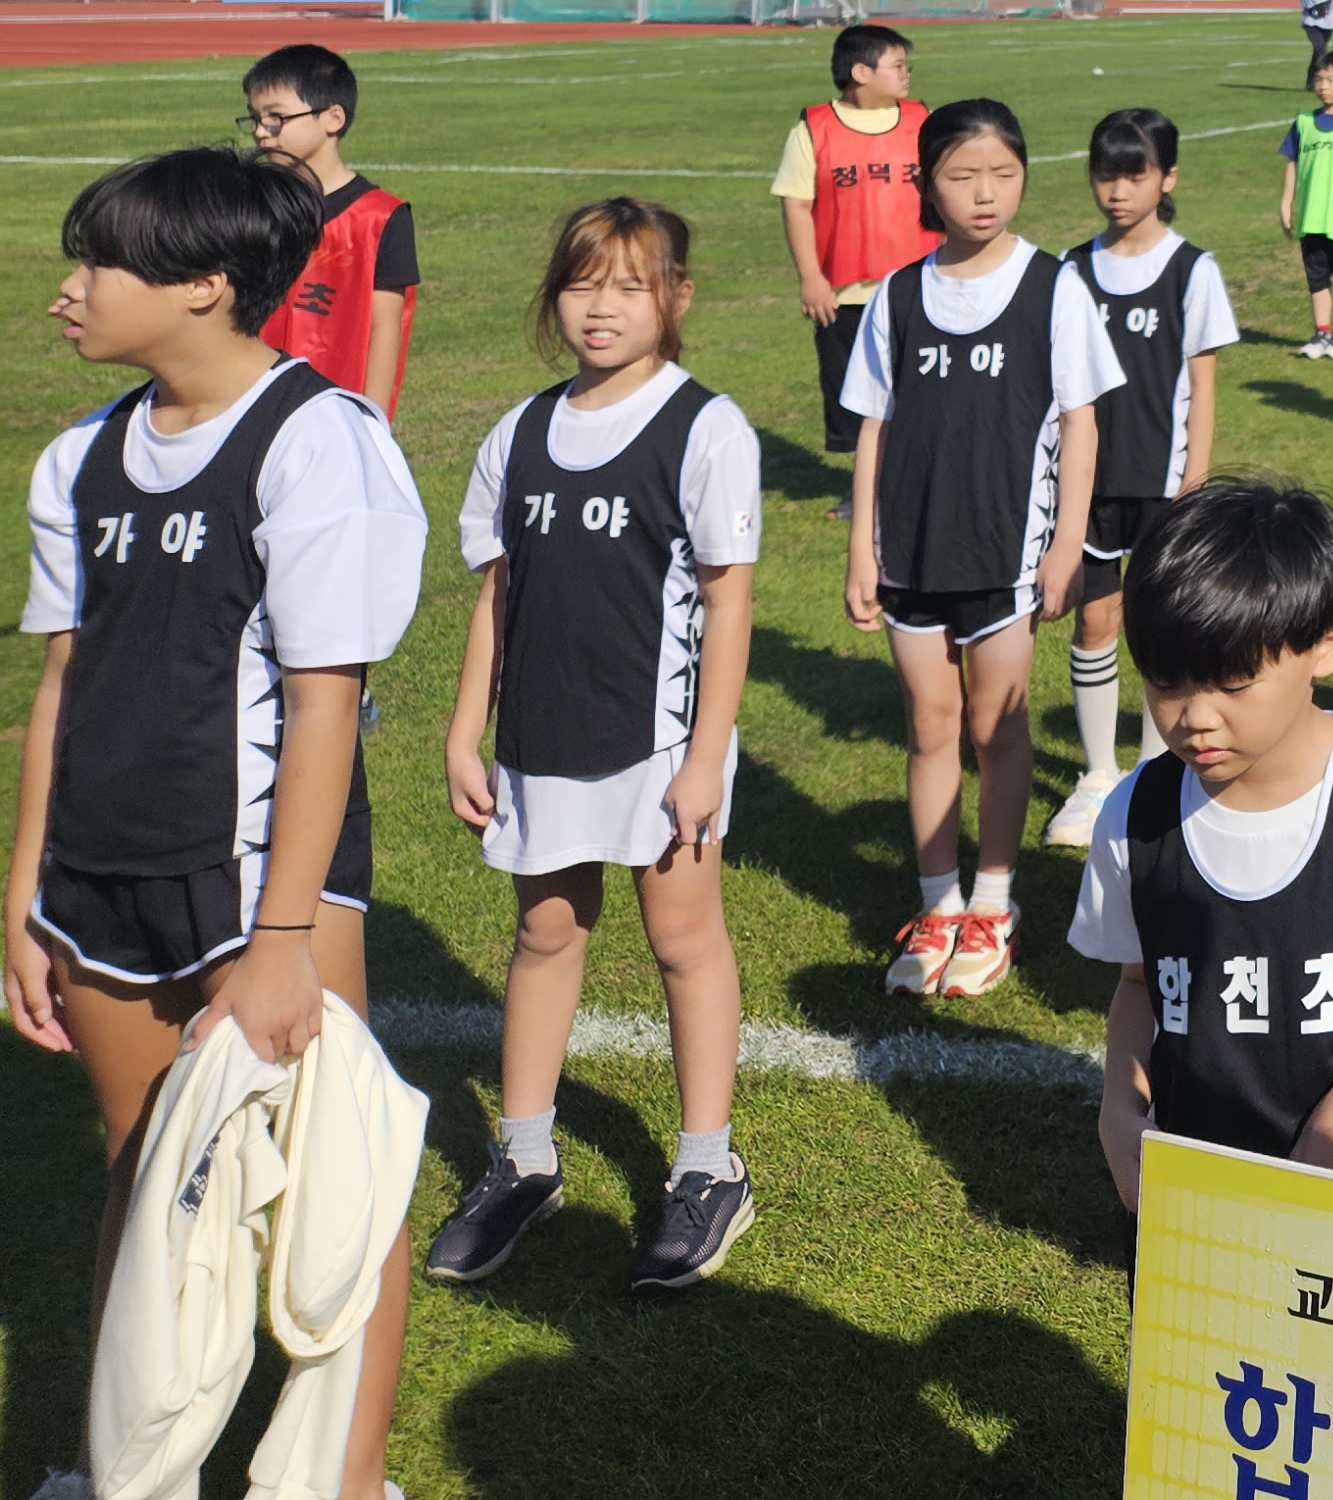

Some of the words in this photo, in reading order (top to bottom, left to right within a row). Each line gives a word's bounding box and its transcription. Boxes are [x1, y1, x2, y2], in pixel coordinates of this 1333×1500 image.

[918, 343, 1005, 378] 가야
[93, 510, 207, 563] 가야
[524, 492, 630, 538] 가야
